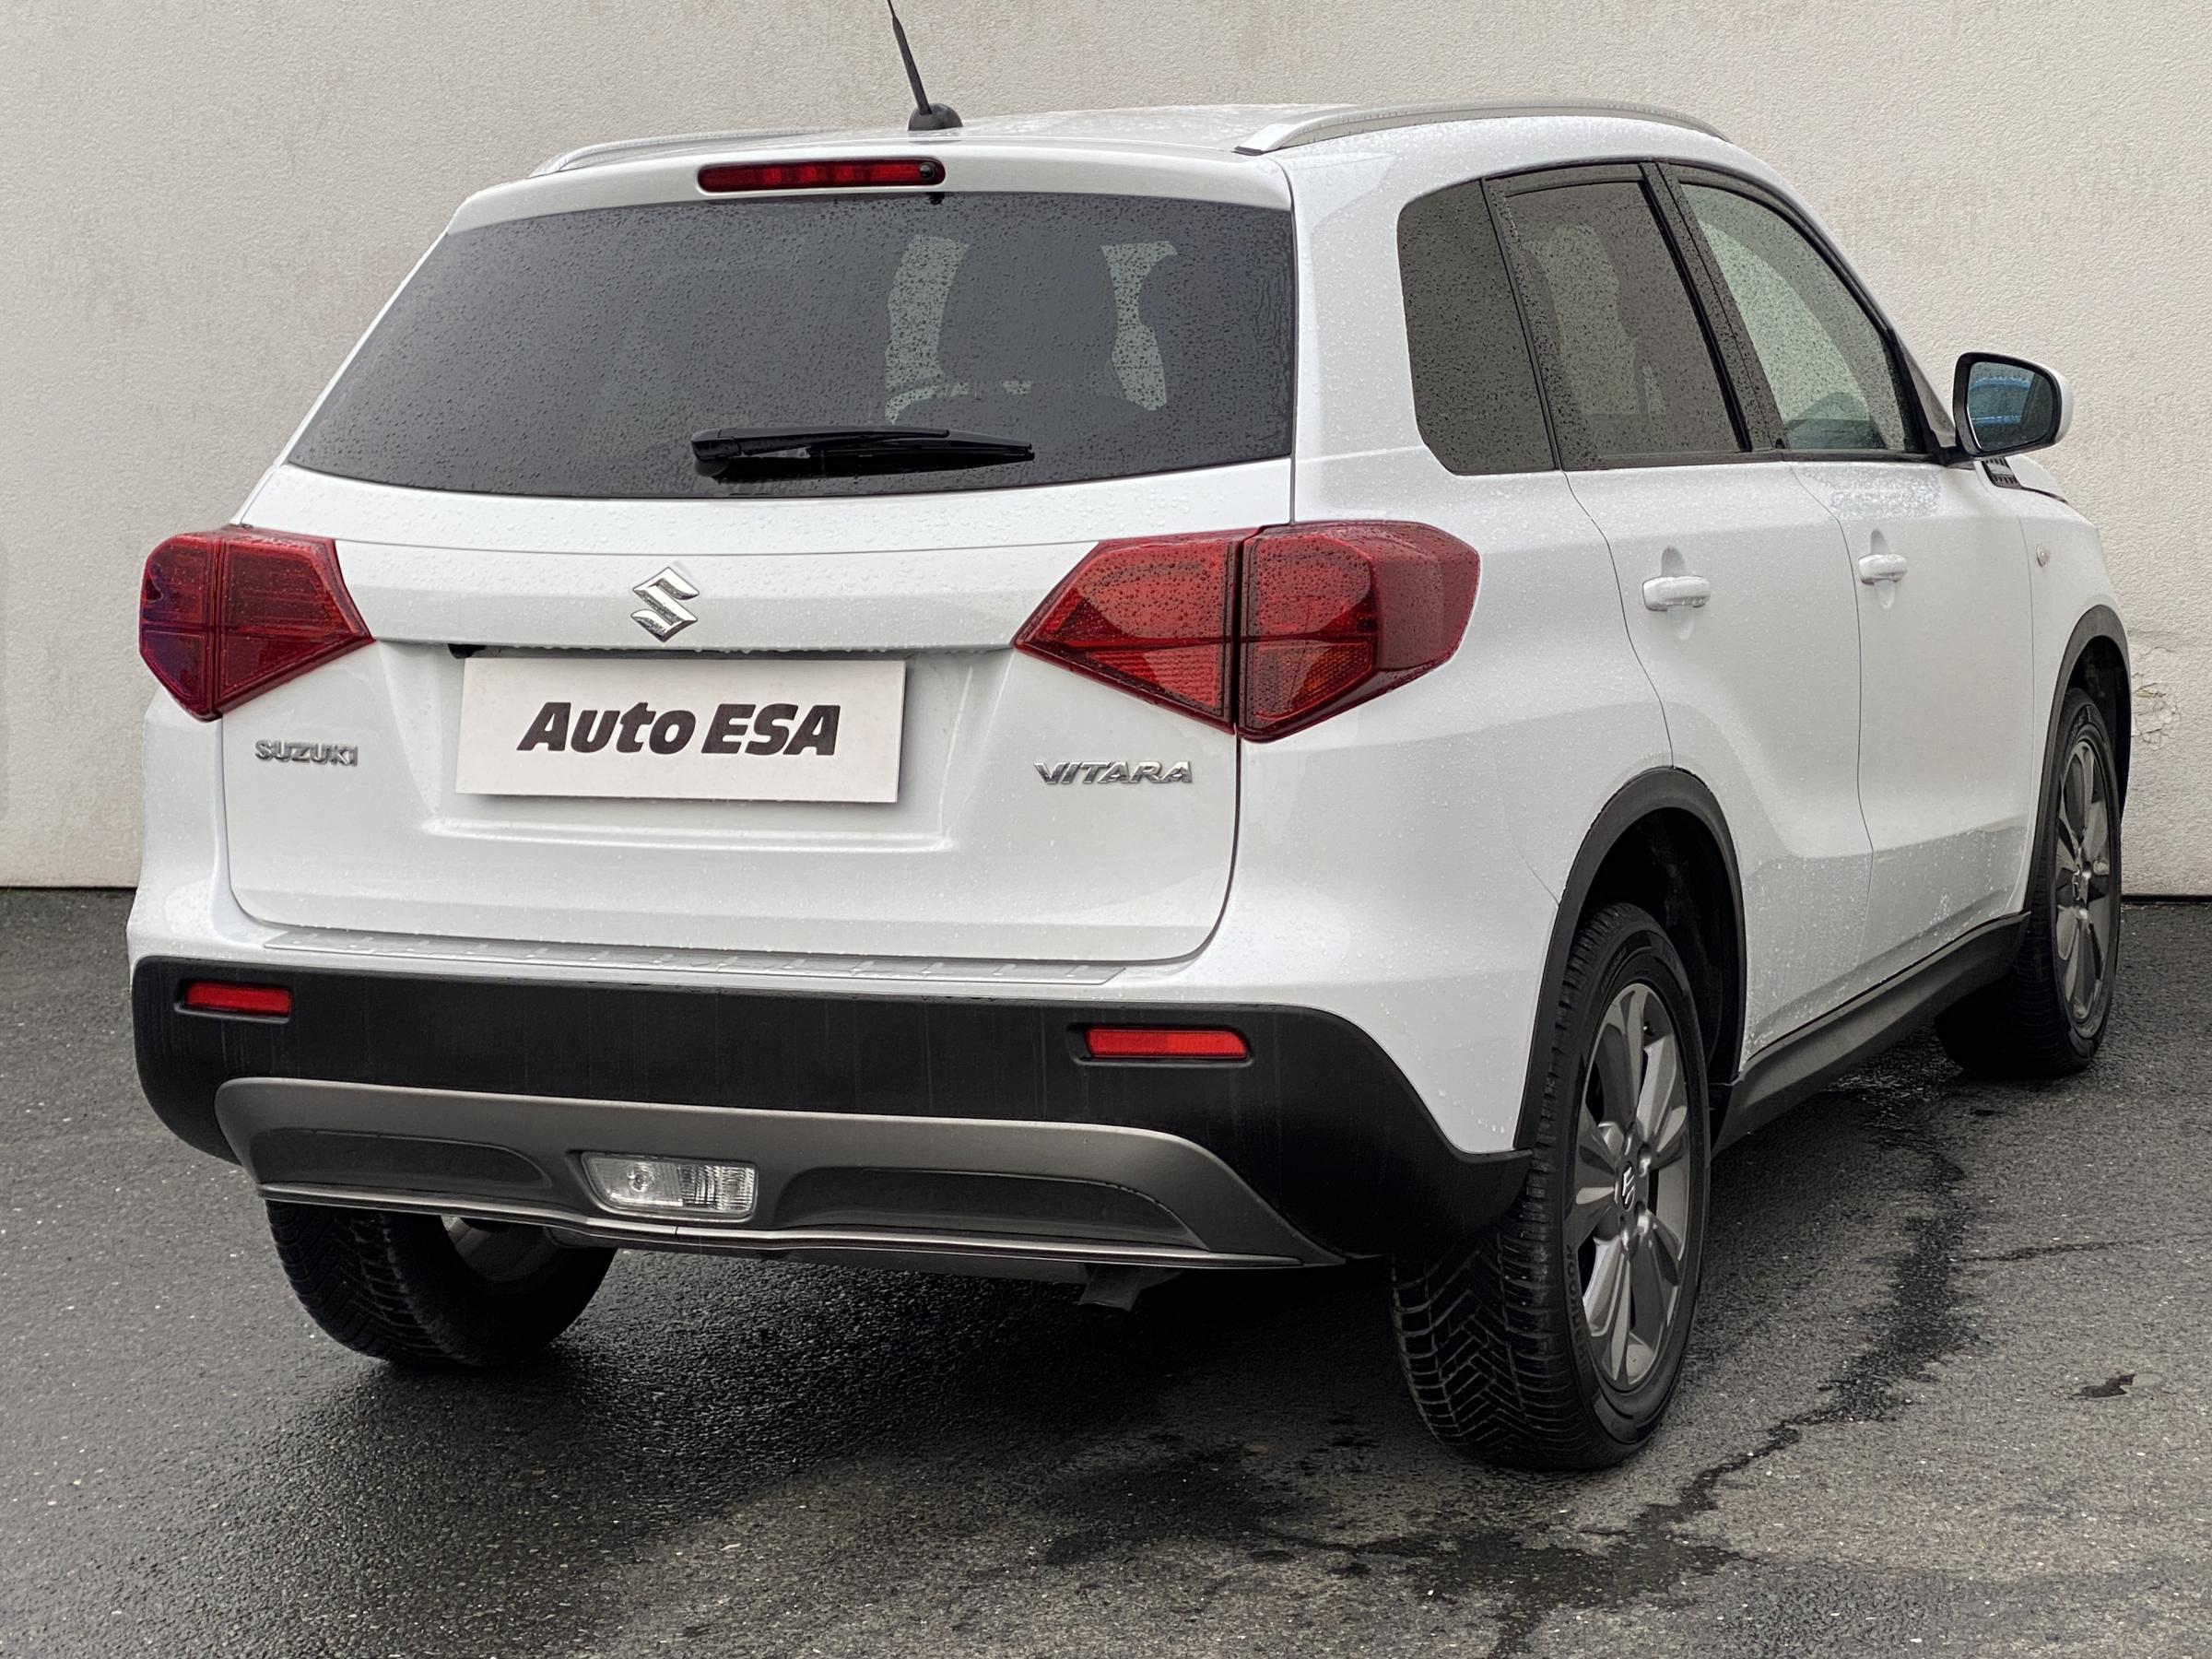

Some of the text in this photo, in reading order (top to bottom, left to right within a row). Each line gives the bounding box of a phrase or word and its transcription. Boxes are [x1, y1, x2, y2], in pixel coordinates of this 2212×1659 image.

[516, 701, 841, 756] Auto ESA
[254, 739, 359, 767] SUZUKI
[1033, 759, 1193, 784] VITARA
